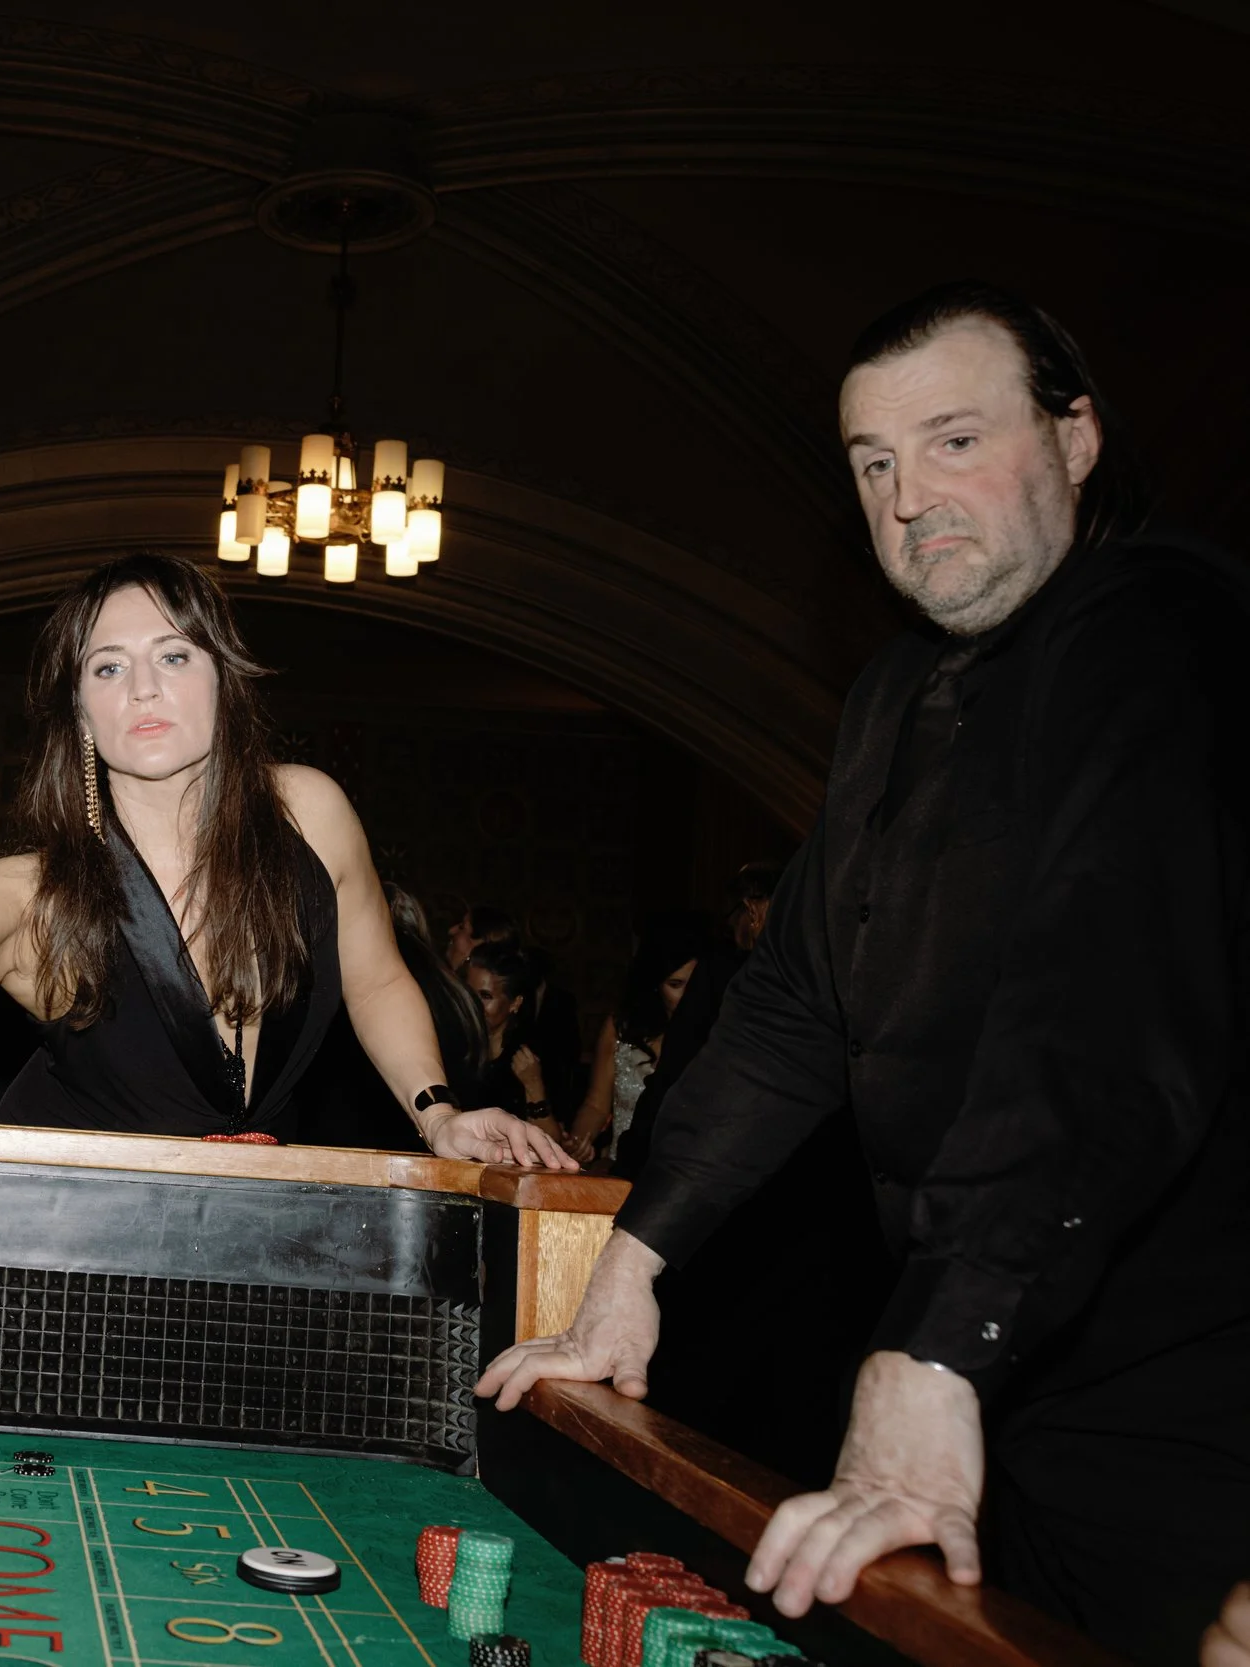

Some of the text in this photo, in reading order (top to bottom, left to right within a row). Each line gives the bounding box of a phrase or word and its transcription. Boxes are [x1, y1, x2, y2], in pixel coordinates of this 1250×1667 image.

[124, 1480, 210, 1497] 4
[134, 1517, 232, 1539] 5
[270, 1551, 309, 1567] ON
[166, 1616, 284, 1646] 8
